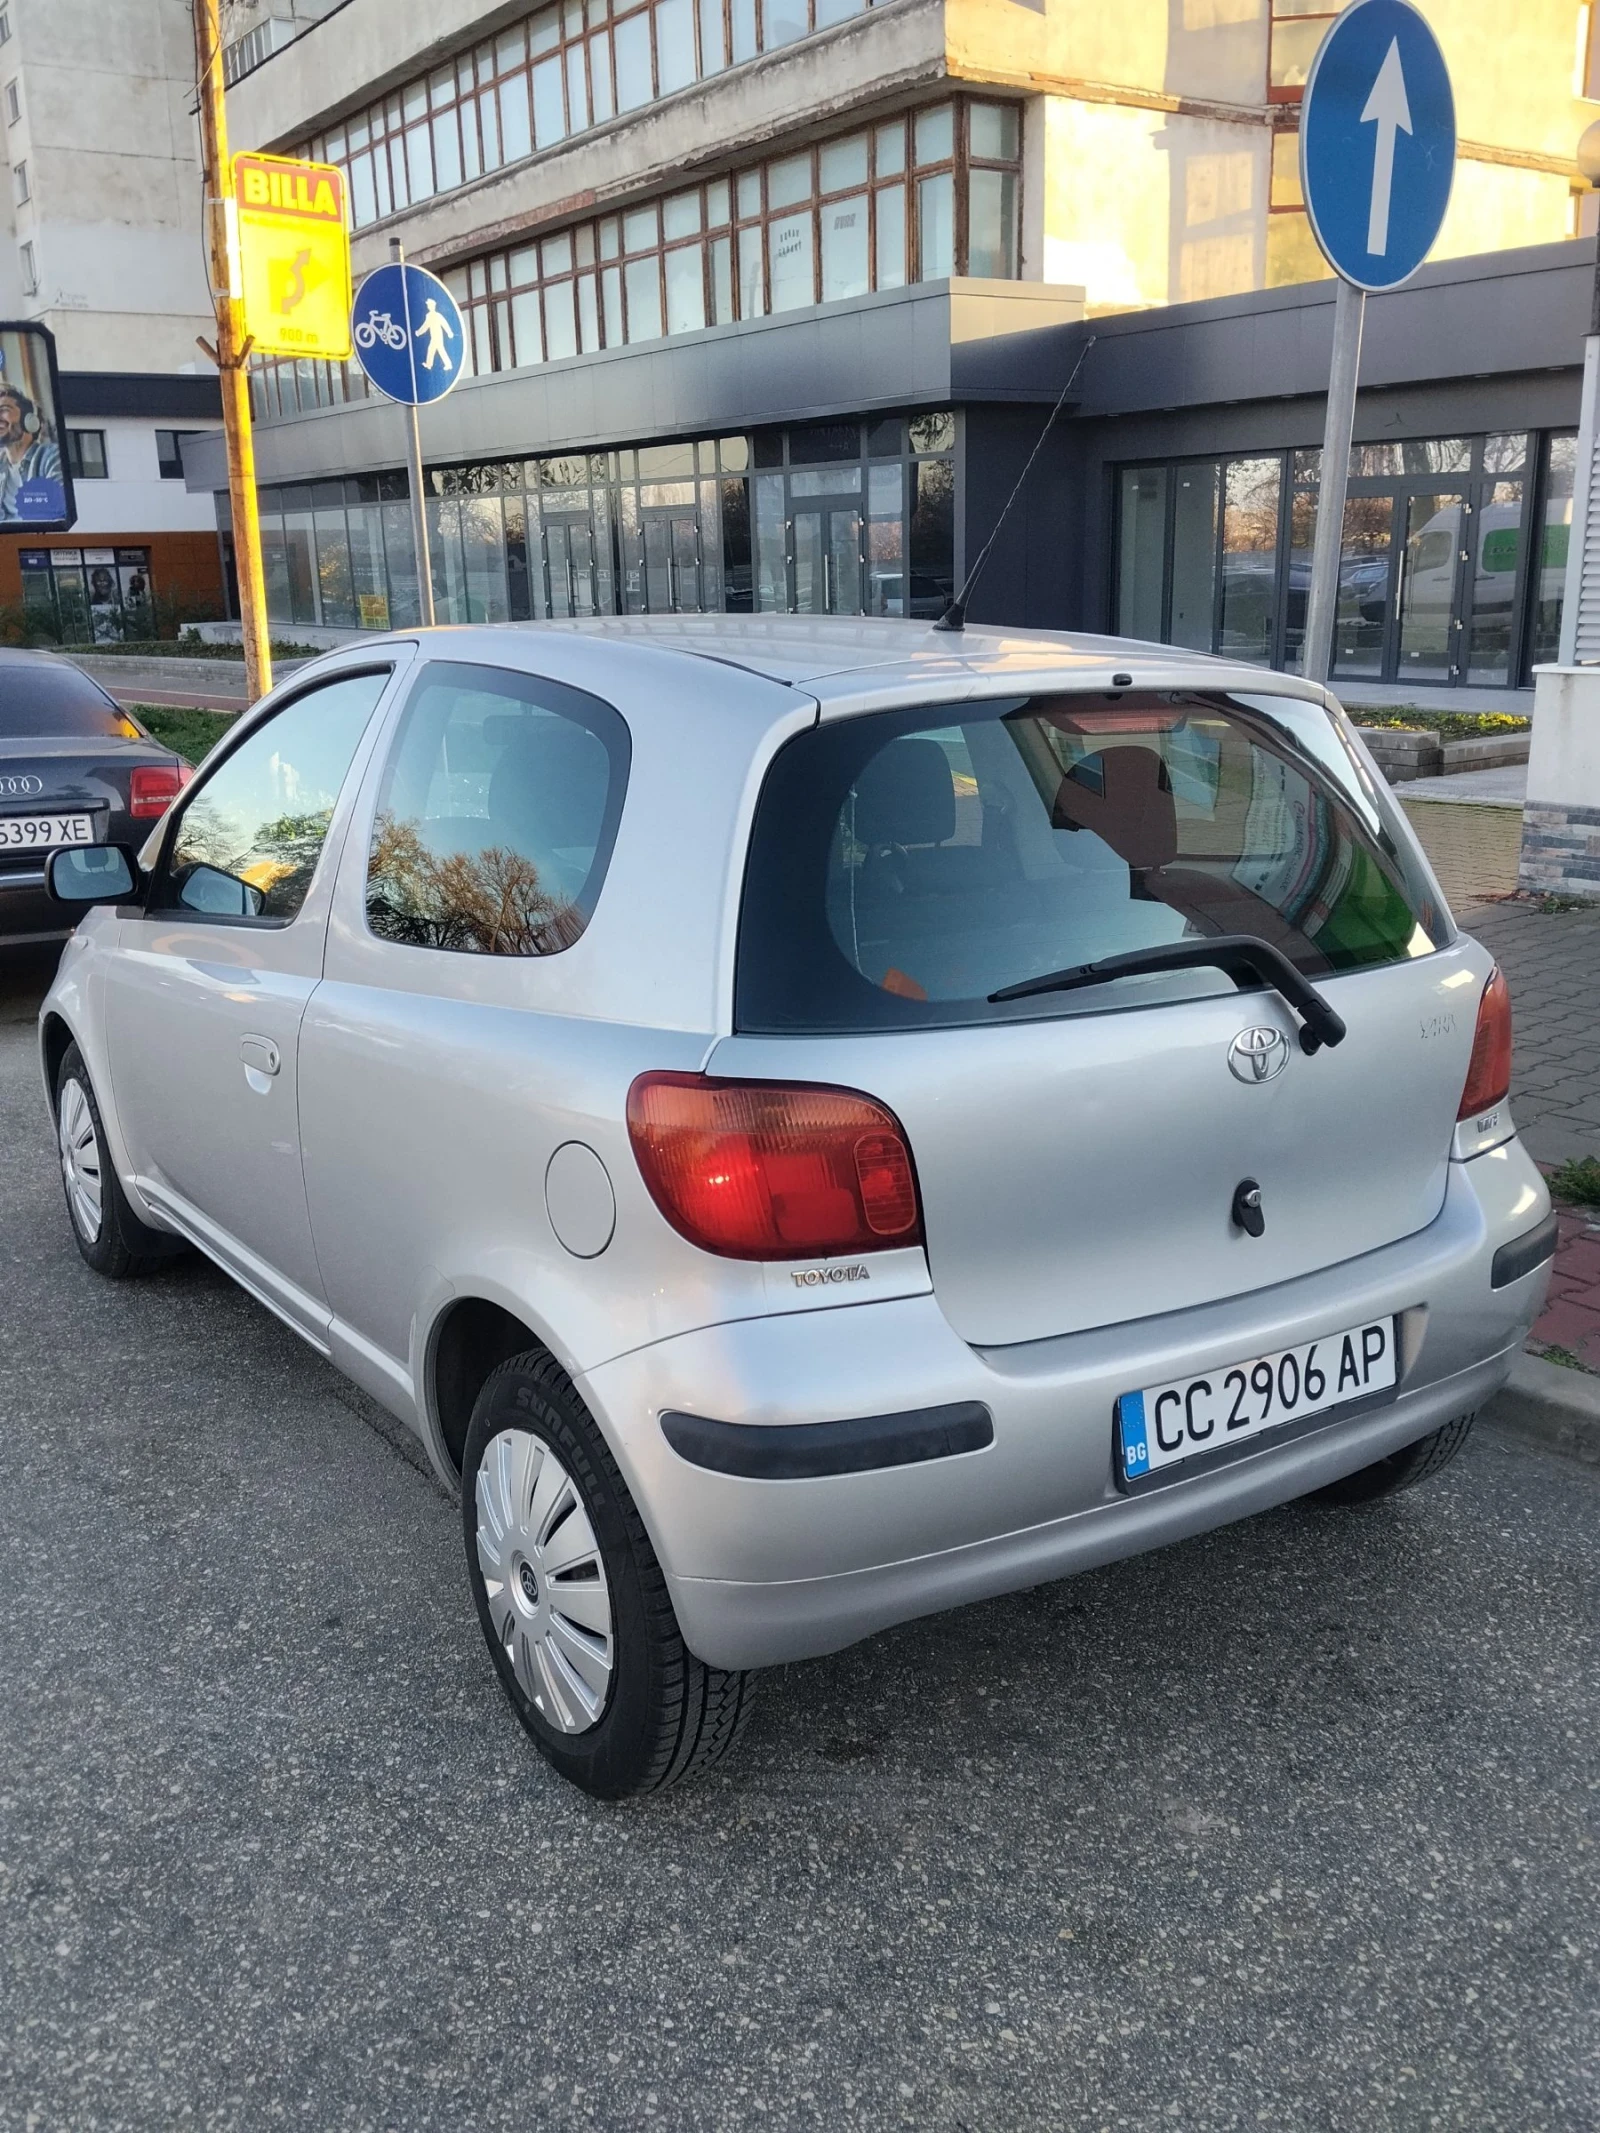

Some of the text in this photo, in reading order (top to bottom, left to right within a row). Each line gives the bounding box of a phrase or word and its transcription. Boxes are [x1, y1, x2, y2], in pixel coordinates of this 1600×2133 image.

[243, 167, 338, 216] BILLA
[279, 327, 319, 345] 900 m
[57, 818, 89, 842] XE
[791, 1263, 870, 1288] TOYOTA
[1155, 1325, 1386, 1452] CC 2906 AP
[1126, 1442, 1147, 1465] BG
